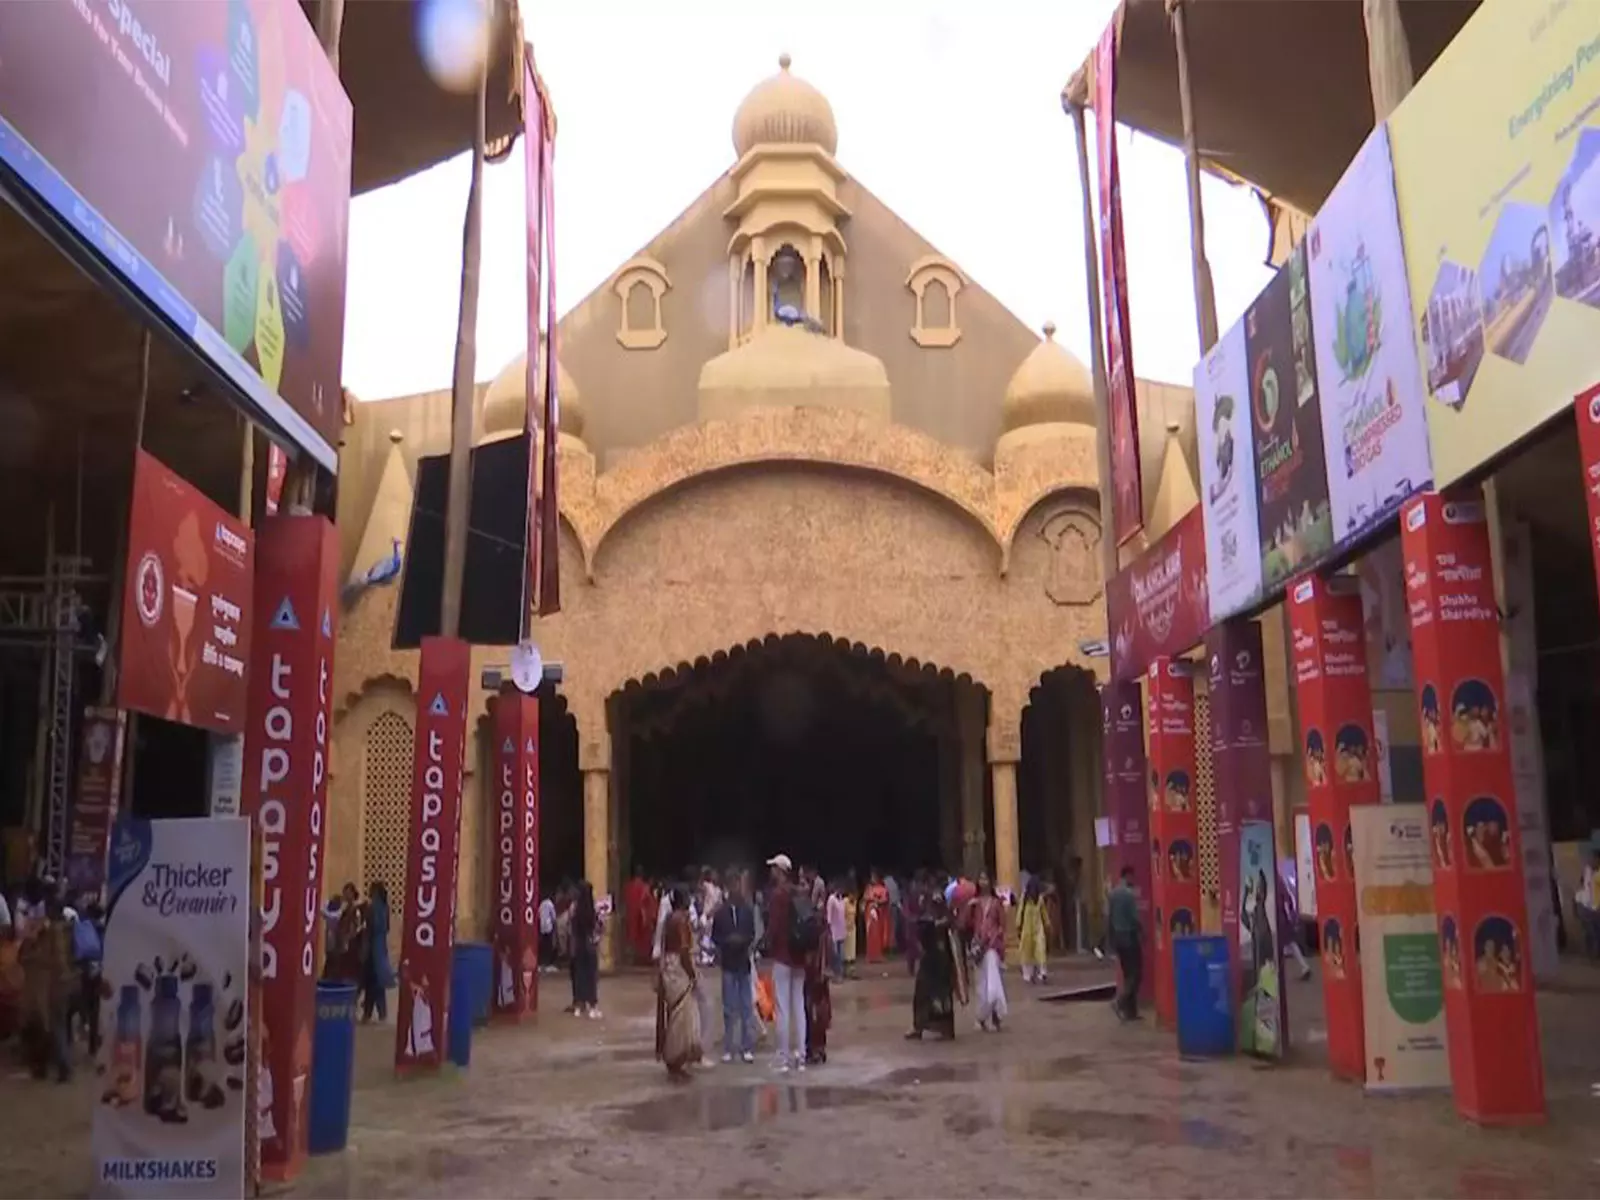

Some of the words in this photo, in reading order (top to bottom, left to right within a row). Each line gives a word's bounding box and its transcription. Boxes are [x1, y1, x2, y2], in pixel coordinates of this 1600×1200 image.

[152, 863, 233, 888] Thicker
[302, 656, 327, 976] tapasya
[415, 730, 443, 947] tapasya
[500, 763, 513, 925] tapasya
[525, 763, 534, 925] tapasya
[142, 880, 158, 907] &
[160, 887, 237, 918] Creamier
[103, 1159, 217, 1181] MILKSHAKES
